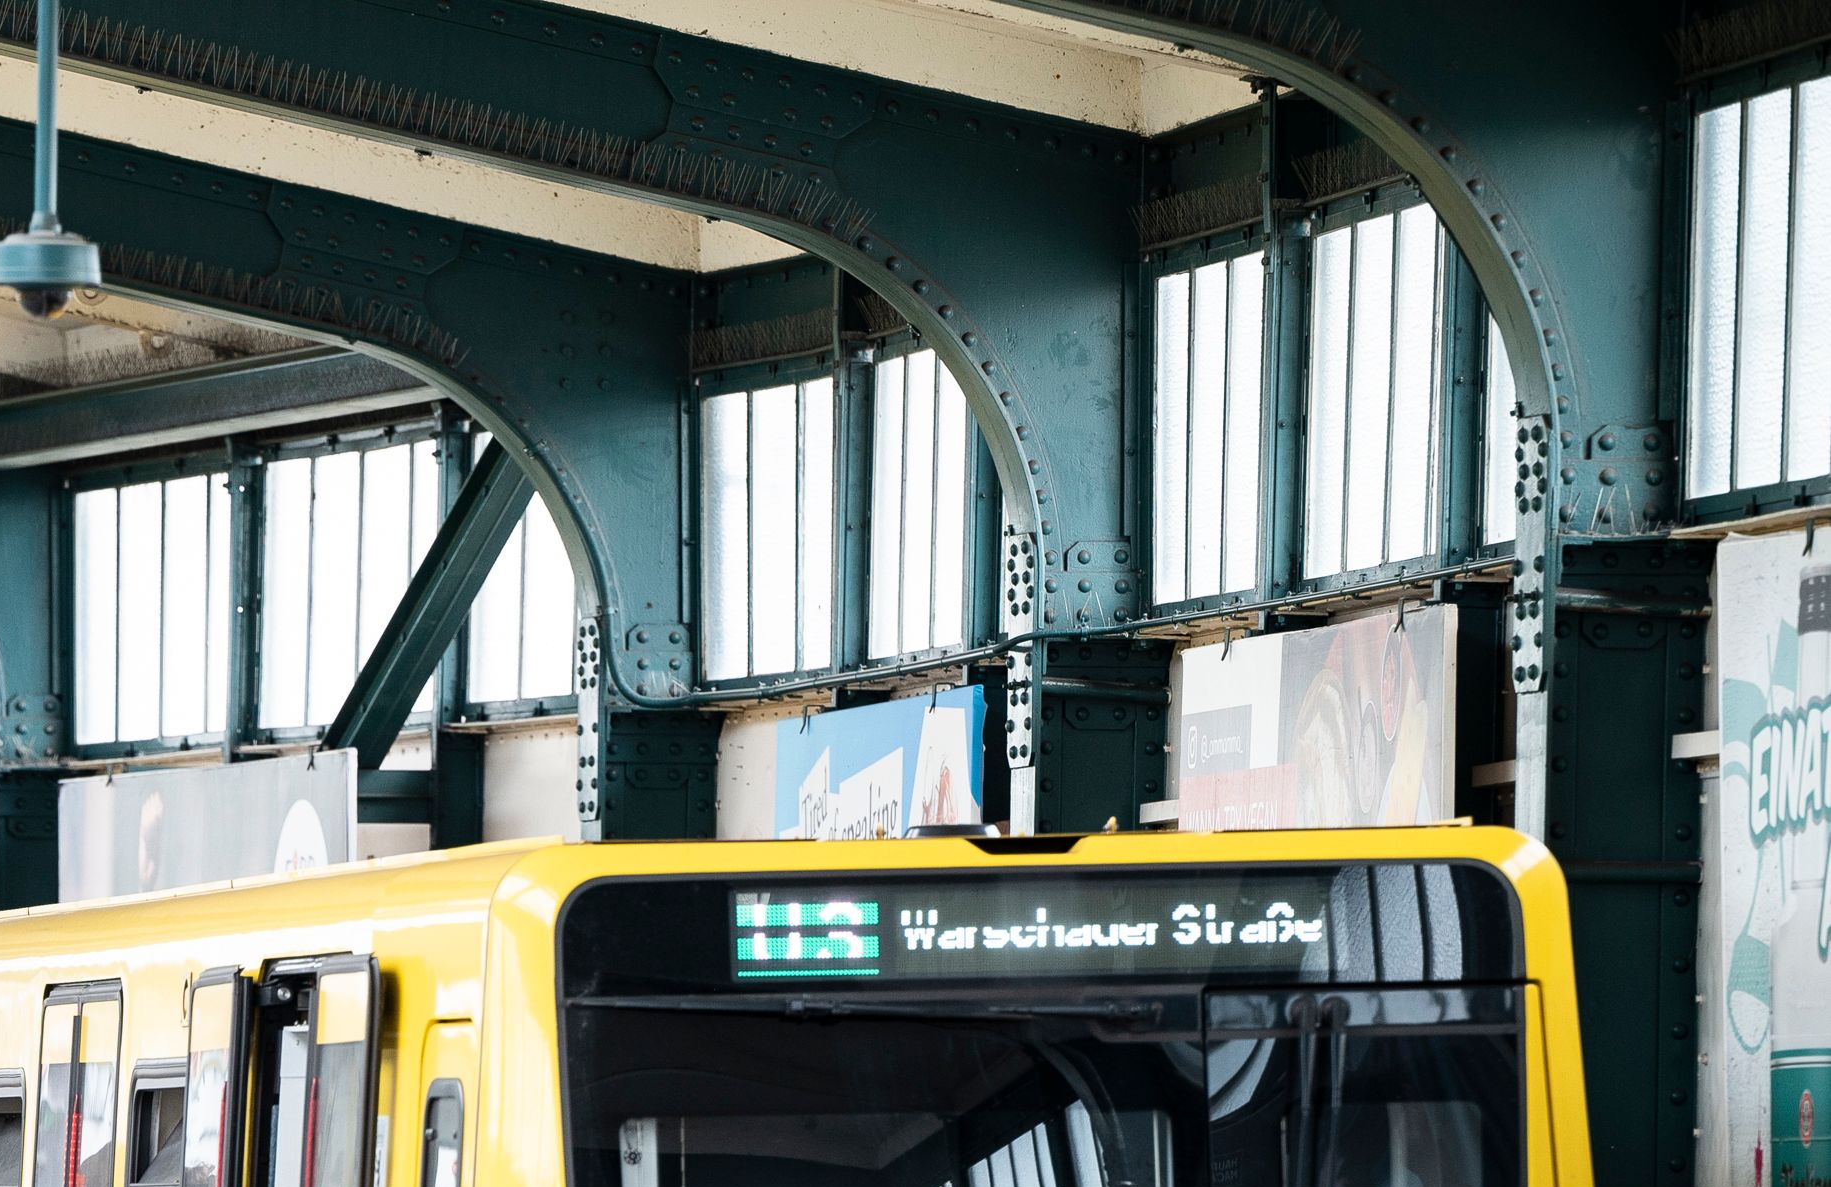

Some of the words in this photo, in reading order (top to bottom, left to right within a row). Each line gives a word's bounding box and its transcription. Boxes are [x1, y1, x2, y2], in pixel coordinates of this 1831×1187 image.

[802, 766, 828, 837] Tired
[828, 807, 839, 839] of
[1186, 808, 1222, 832] WANNA
[1224, 804, 1244, 831] TRY
[1244, 799, 1278, 830] VEGAN
[753, 902, 863, 960] U3
[901, 907, 1159, 950] Warschauer
